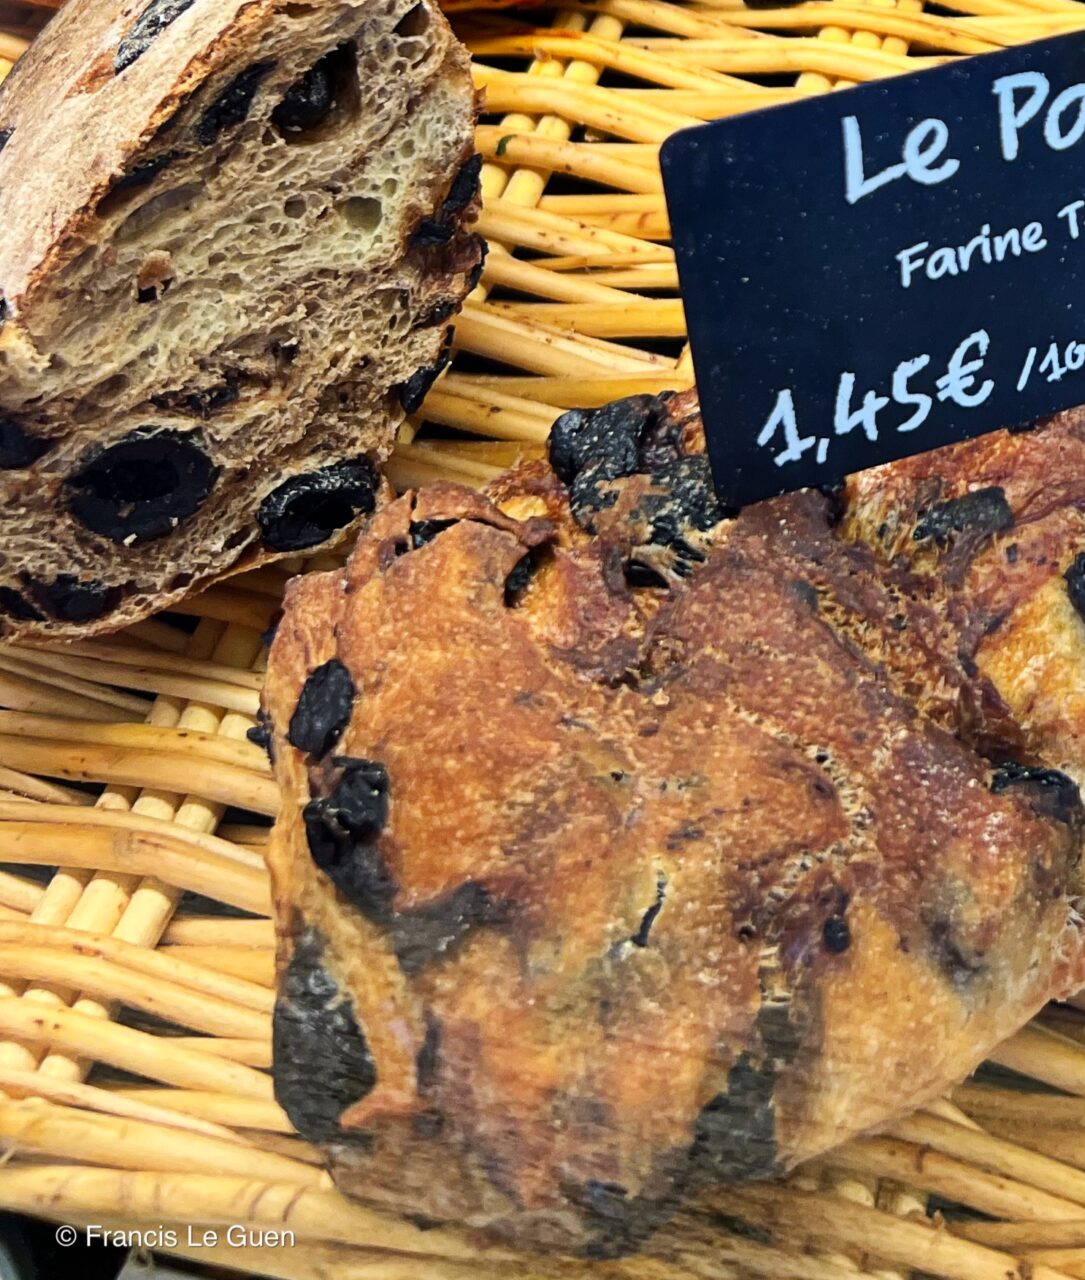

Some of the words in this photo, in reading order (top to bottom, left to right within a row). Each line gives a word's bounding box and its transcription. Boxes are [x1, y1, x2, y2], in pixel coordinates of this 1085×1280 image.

[844, 116, 960, 203] Le
[896, 222, 1047, 287] Farine
[756, 329, 995, 465] 1,45€
